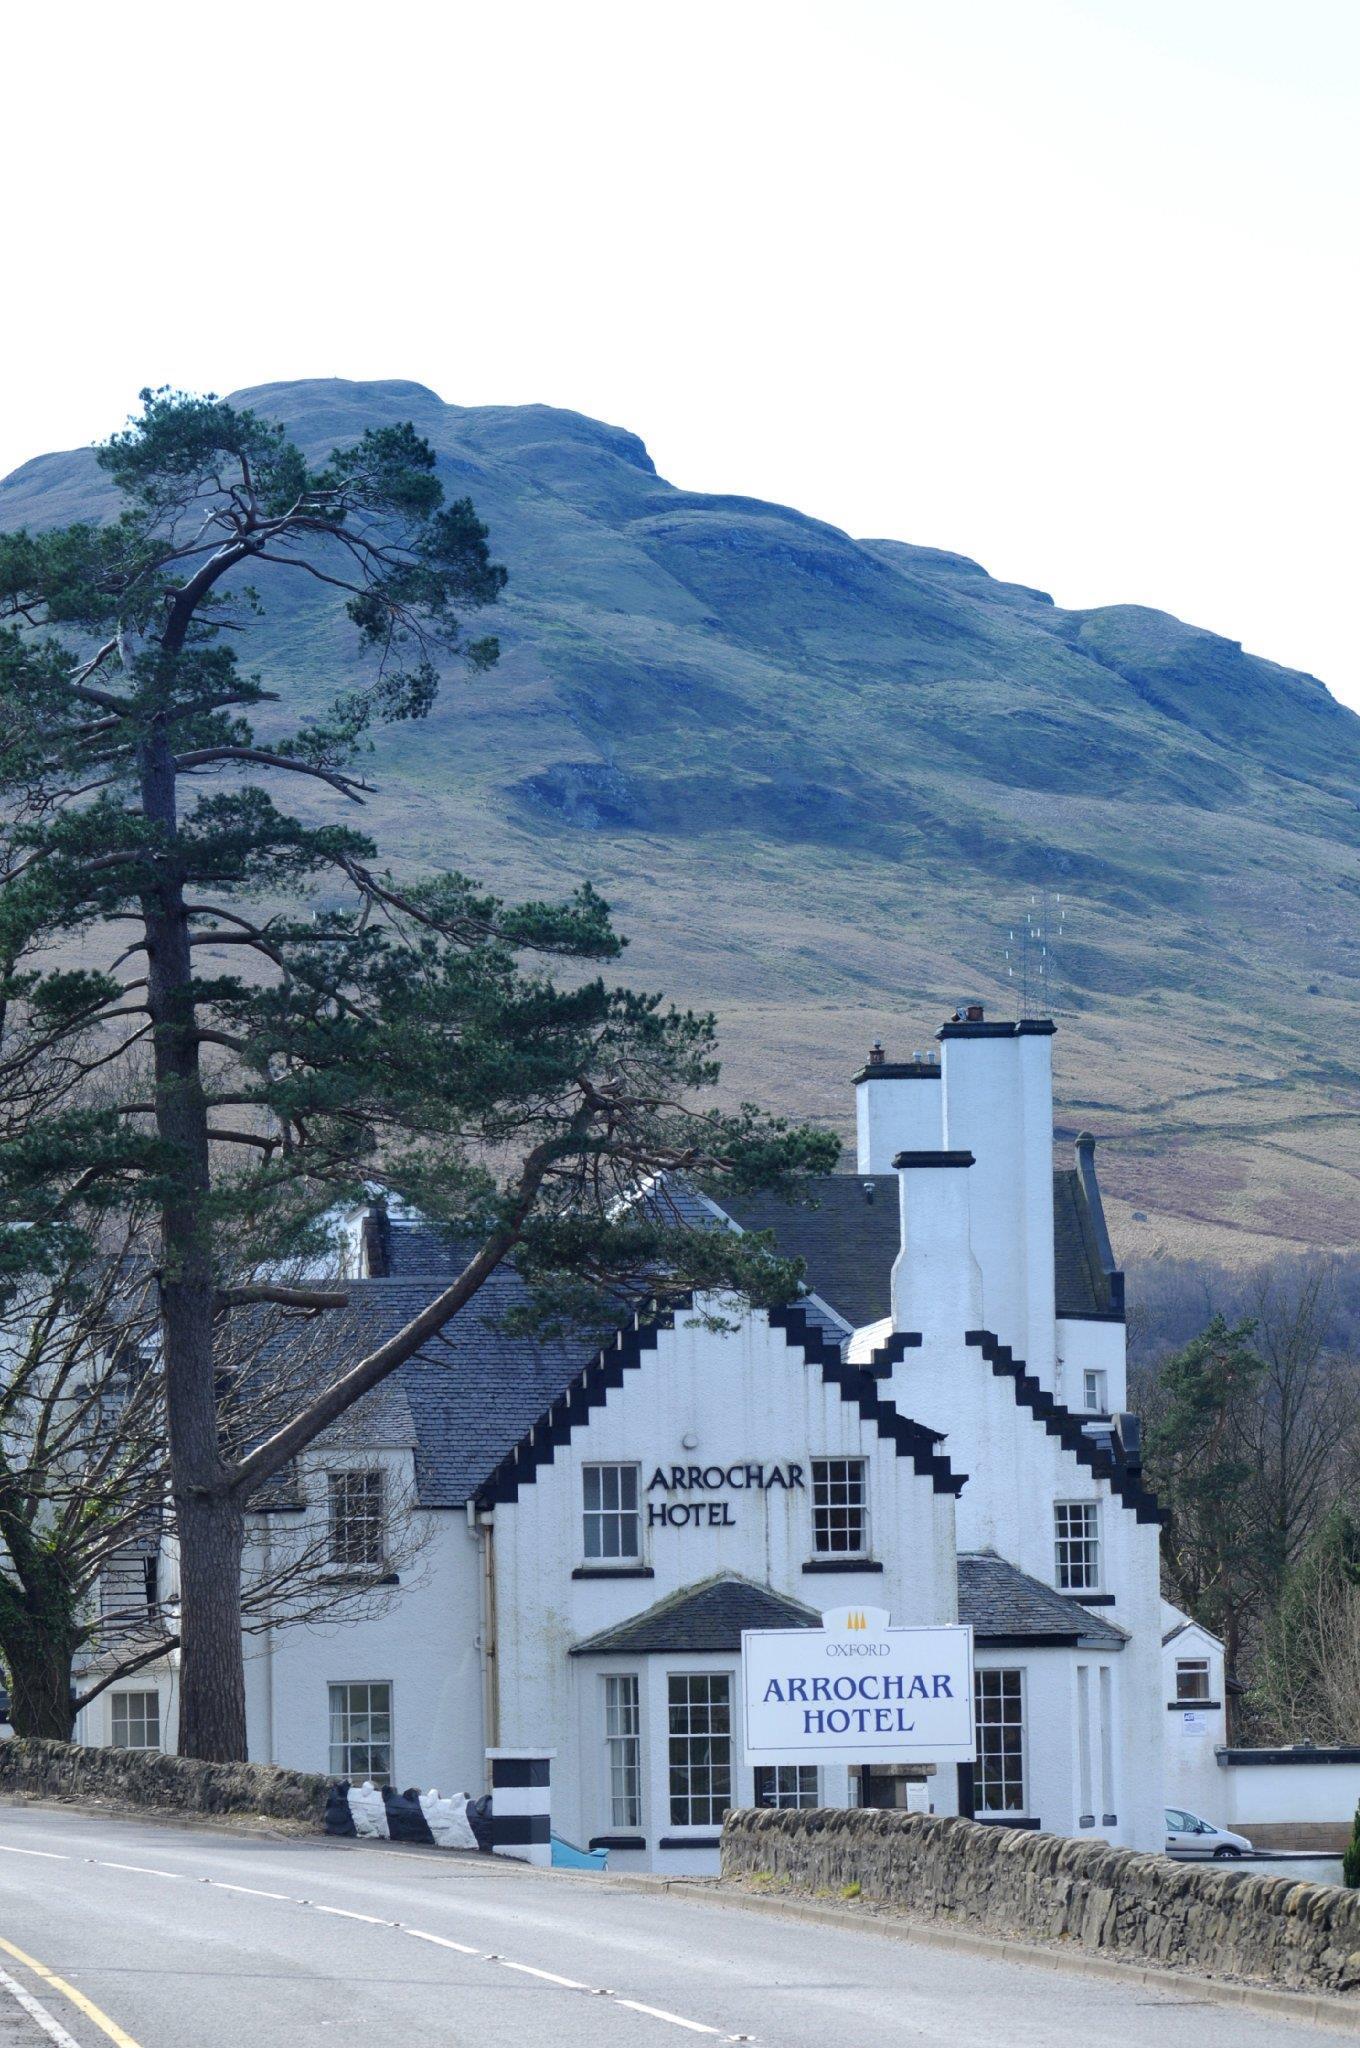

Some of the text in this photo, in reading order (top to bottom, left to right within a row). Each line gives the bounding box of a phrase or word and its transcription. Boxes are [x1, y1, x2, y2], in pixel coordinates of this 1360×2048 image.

[648, 1464, 804, 1490] ARROCHAR
[648, 1503, 736, 1527] HOTEL
[826, 1644, 891, 1657] OXFORD
[763, 1674, 954, 1702] ARROCHAR
[803, 1708, 915, 1733] HOTEL
